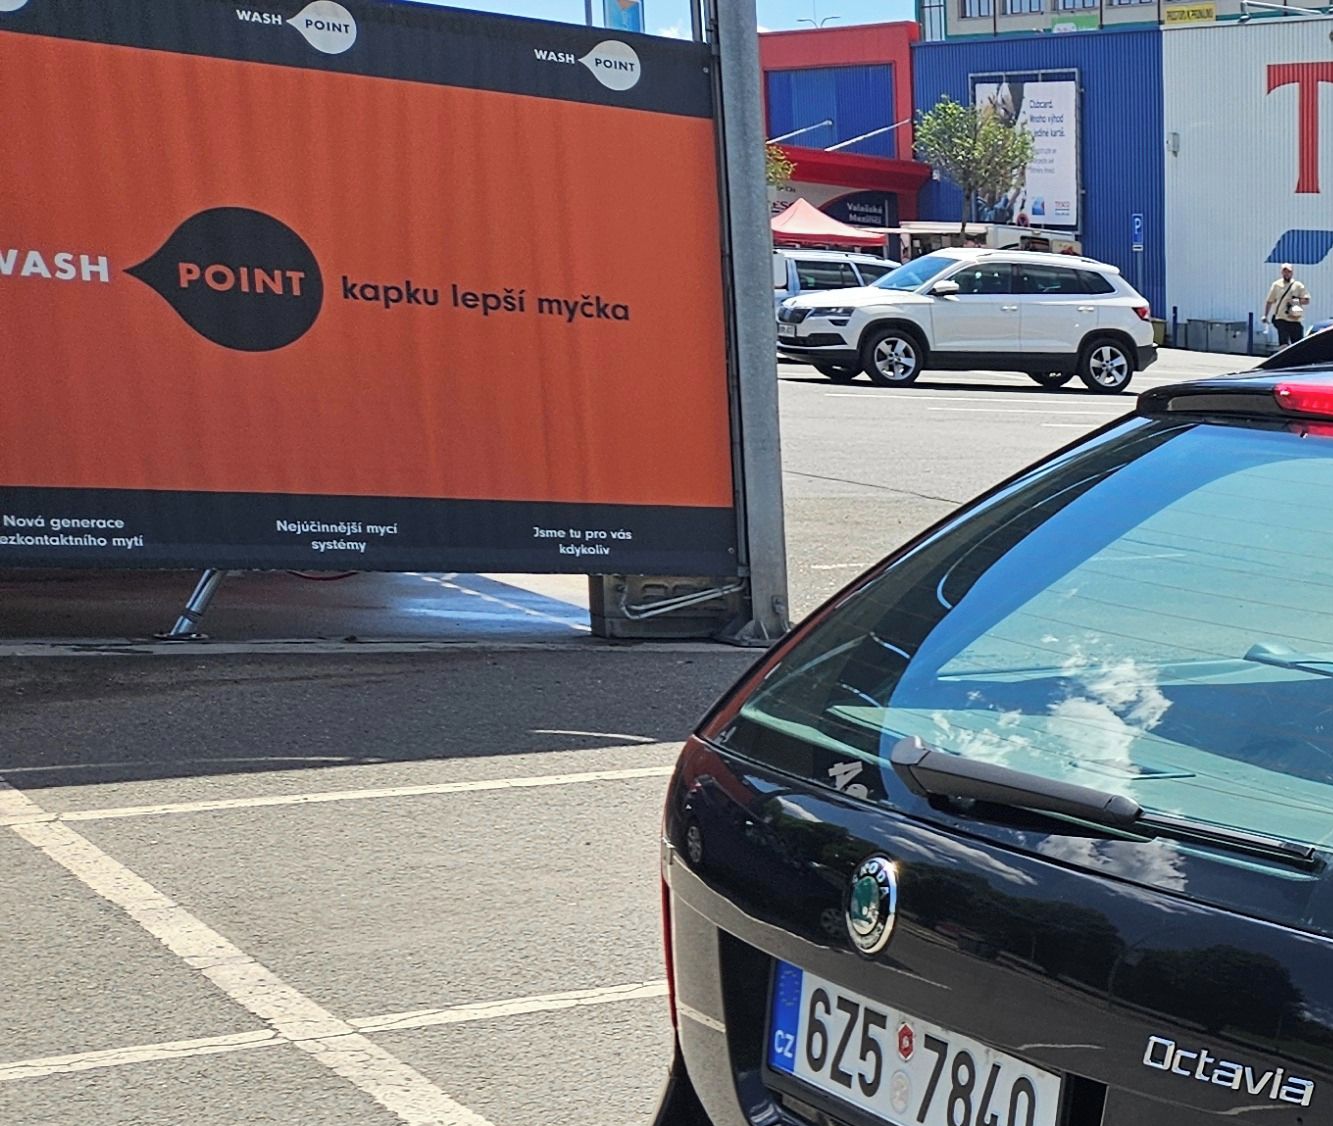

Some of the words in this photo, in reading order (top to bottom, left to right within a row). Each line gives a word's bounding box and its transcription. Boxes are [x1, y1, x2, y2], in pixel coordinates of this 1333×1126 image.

[236, 9, 282, 25] WASH
[305, 19, 350, 34] POINT
[534, 48, 575, 64] WASH
[595, 58, 635, 72] POINT
[178, 262, 305, 296] POINT
[341, 275, 439, 309] kapku
[451, 284, 526, 316] lepší
[537, 294, 630, 323] myčka
[3, 514, 45, 527] Nová
[50, 518, 125, 531] generace
[276, 520, 362, 535] Nejúčinnější
[366, 522, 398, 537] mycí
[0, 533, 107, 547] ezkontaktního
[112, 534, 144, 549] mytí
[533, 526, 566, 538] Jsme
[569, 528, 581, 539] tu
[585, 530, 607, 541] pro
[610, 528, 632, 540] vás
[311, 539, 367, 553] systémy
[559, 543, 610, 557] kdykoliv
[774, 1029, 795, 1058] CZ
[805, 987, 888, 1098] 6Z5
[1143, 1035, 1315, 1107] Octavia
